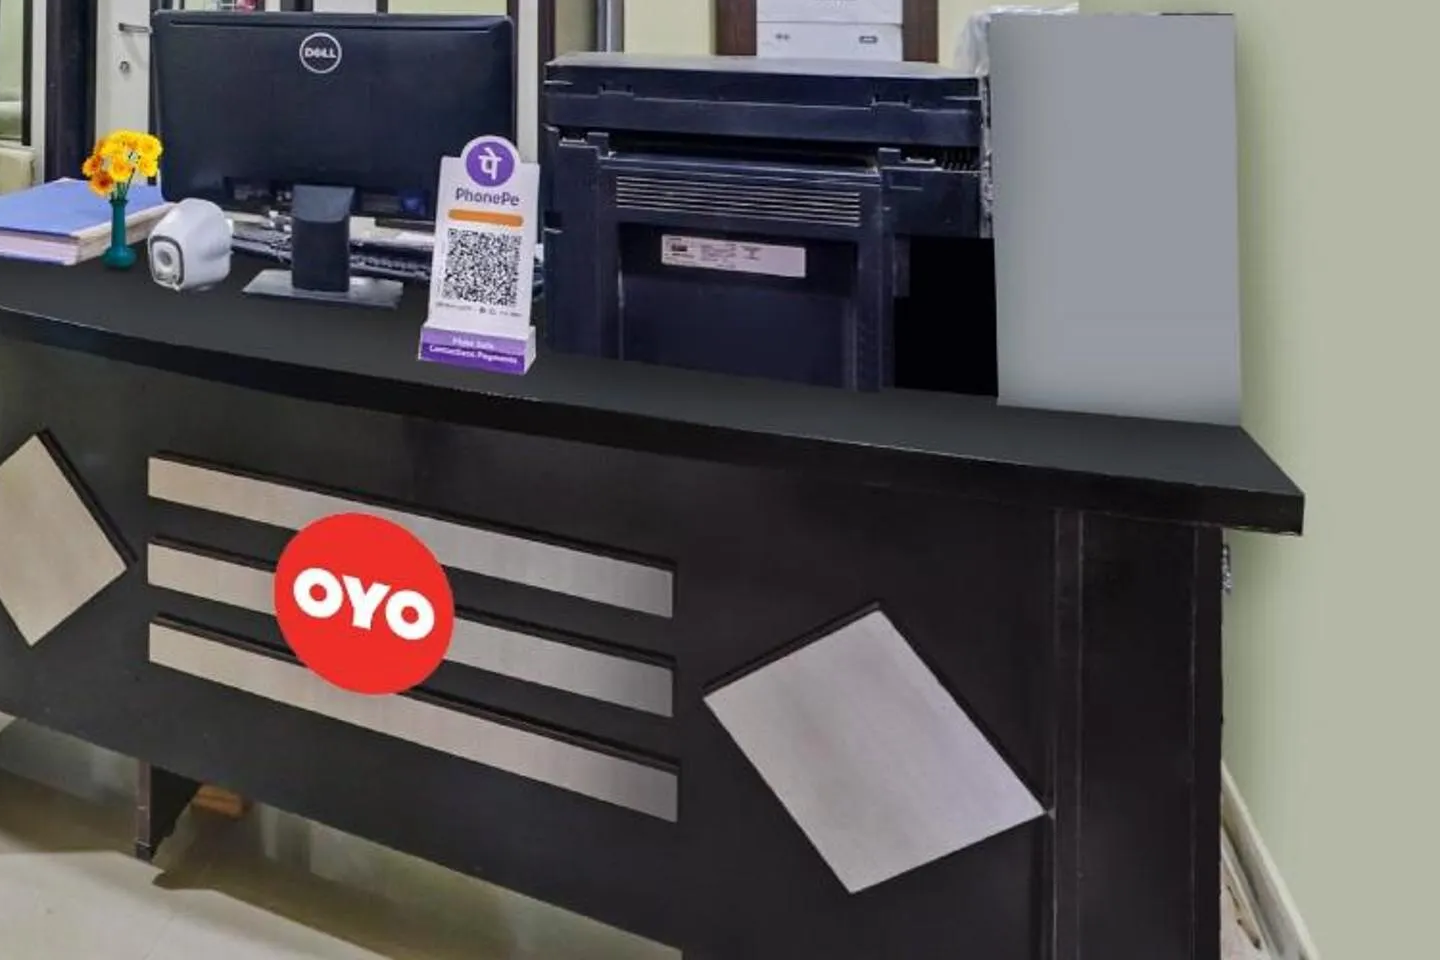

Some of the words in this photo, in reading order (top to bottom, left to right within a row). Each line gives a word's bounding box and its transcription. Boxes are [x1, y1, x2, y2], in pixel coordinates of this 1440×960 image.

[304, 47, 337, 58] DELL
[455, 187, 520, 206] PhonePe
[293, 567, 435, 641] OYO
